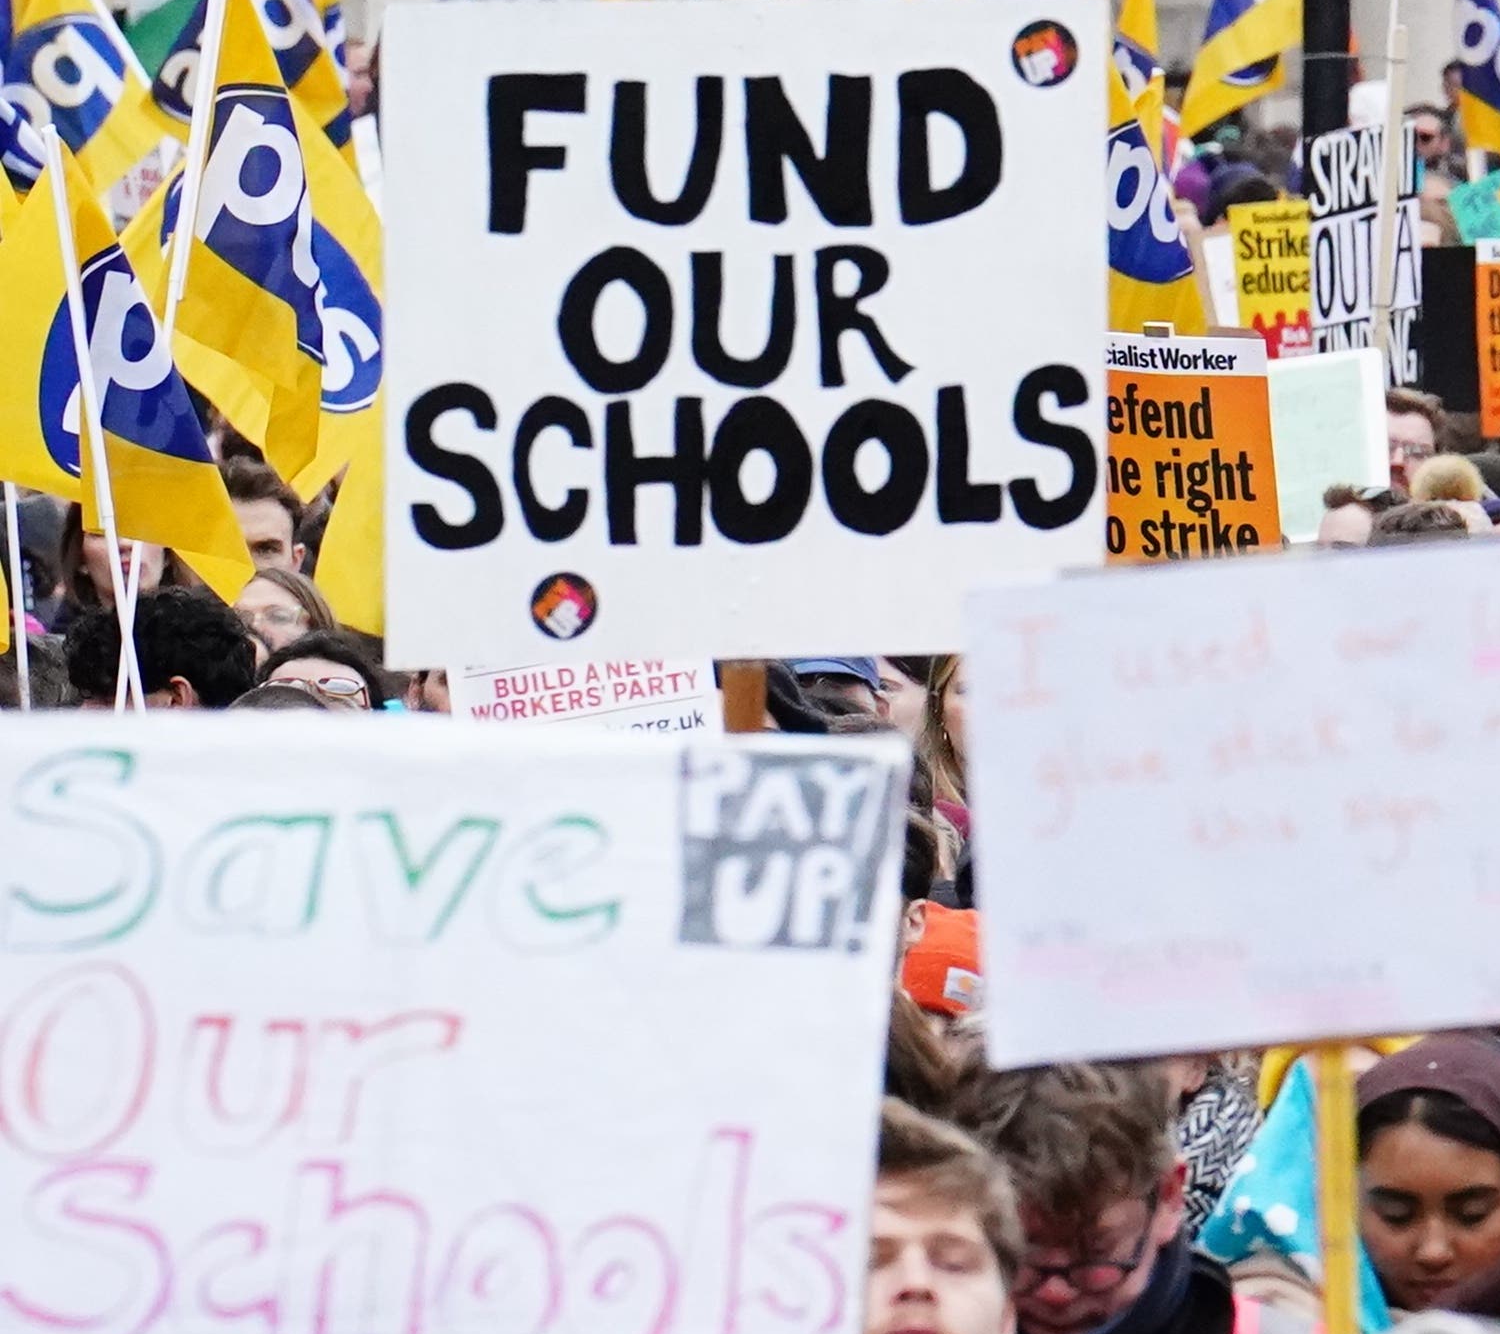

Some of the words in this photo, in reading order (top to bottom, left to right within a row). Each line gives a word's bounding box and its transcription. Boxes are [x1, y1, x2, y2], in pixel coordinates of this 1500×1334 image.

[486, 67, 1004, 234] FUND
[1239, 228, 1310, 261] Strike
[556, 243, 917, 395] OUR
[1159, 348, 1237, 371] Worker
[1107, 383, 1214, 440] efend
[403, 363, 1098, 551] SCHOOLS
[1154, 447, 1257, 513] right
[1107, 515, 1127, 554] o
[1140, 507, 1259, 560] strike
[471, 684, 607, 723] WORKERS'
[613, 668, 699, 704] PARTY
[493, 667, 576, 699] BUILD
[585, 662, 600, 684] A
[605, 658, 666, 680] NEW
[681, 751, 878, 847] PAY
[5, 747, 624, 952] Save
[708, 845, 872, 955] UP!
[0, 960, 464, 1165] Our
